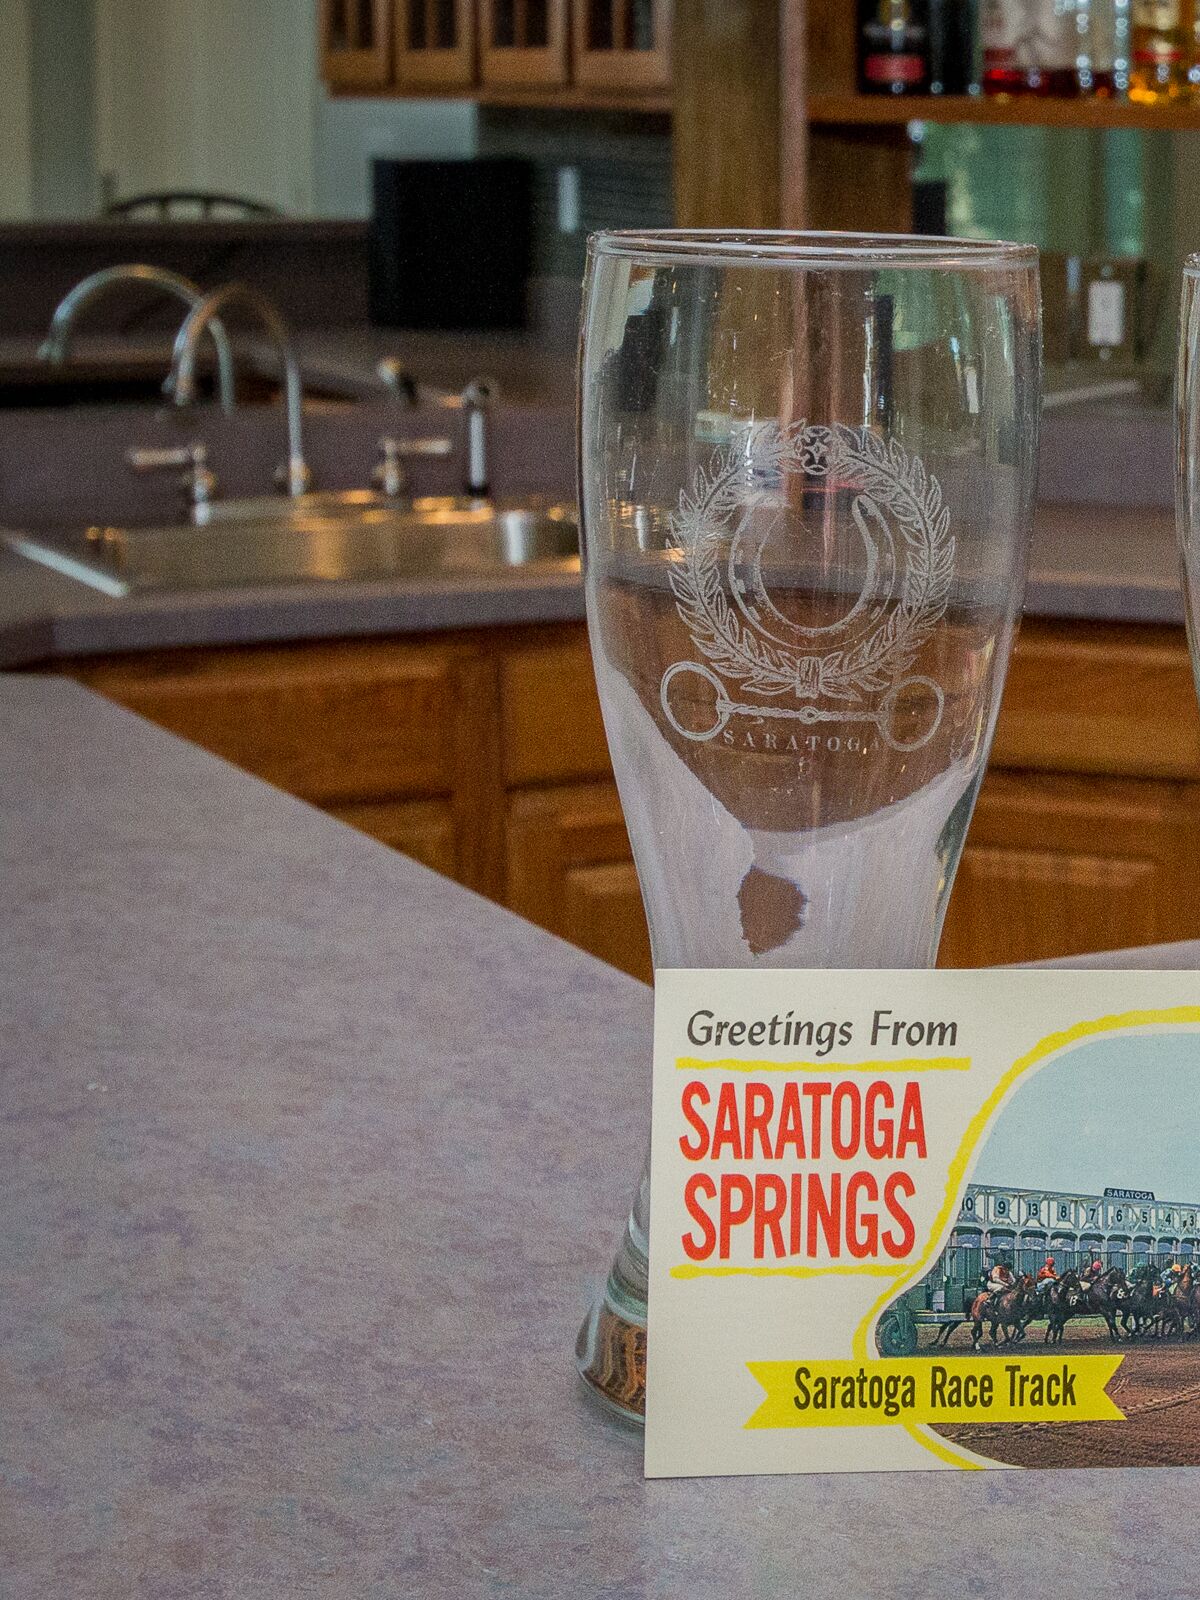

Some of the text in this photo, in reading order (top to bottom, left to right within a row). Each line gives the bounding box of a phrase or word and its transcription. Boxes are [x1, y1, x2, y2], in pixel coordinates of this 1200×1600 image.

[687, 1009, 958, 1057] Greetings From
[679, 1080, 928, 1161] SARATOGA
[681, 1170, 917, 1261] SPRINGS
[997, 1200, 1007, 1215] 9
[1028, 1202, 1039, 1217] 13
[1060, 1205, 1068, 1219] 8
[1089, 1207, 1097, 1221] 7
[1116, 1209, 1123, 1223] 6
[1141, 1211, 1148, 1224] 5
[1165, 1212, 1172, 1225] 4
[1189, 1214, 1196, 1227] 3
[1106, 1188, 1154, 1201] SARATOGA
[793, 1364, 1077, 1417] Saratoga Race Track
